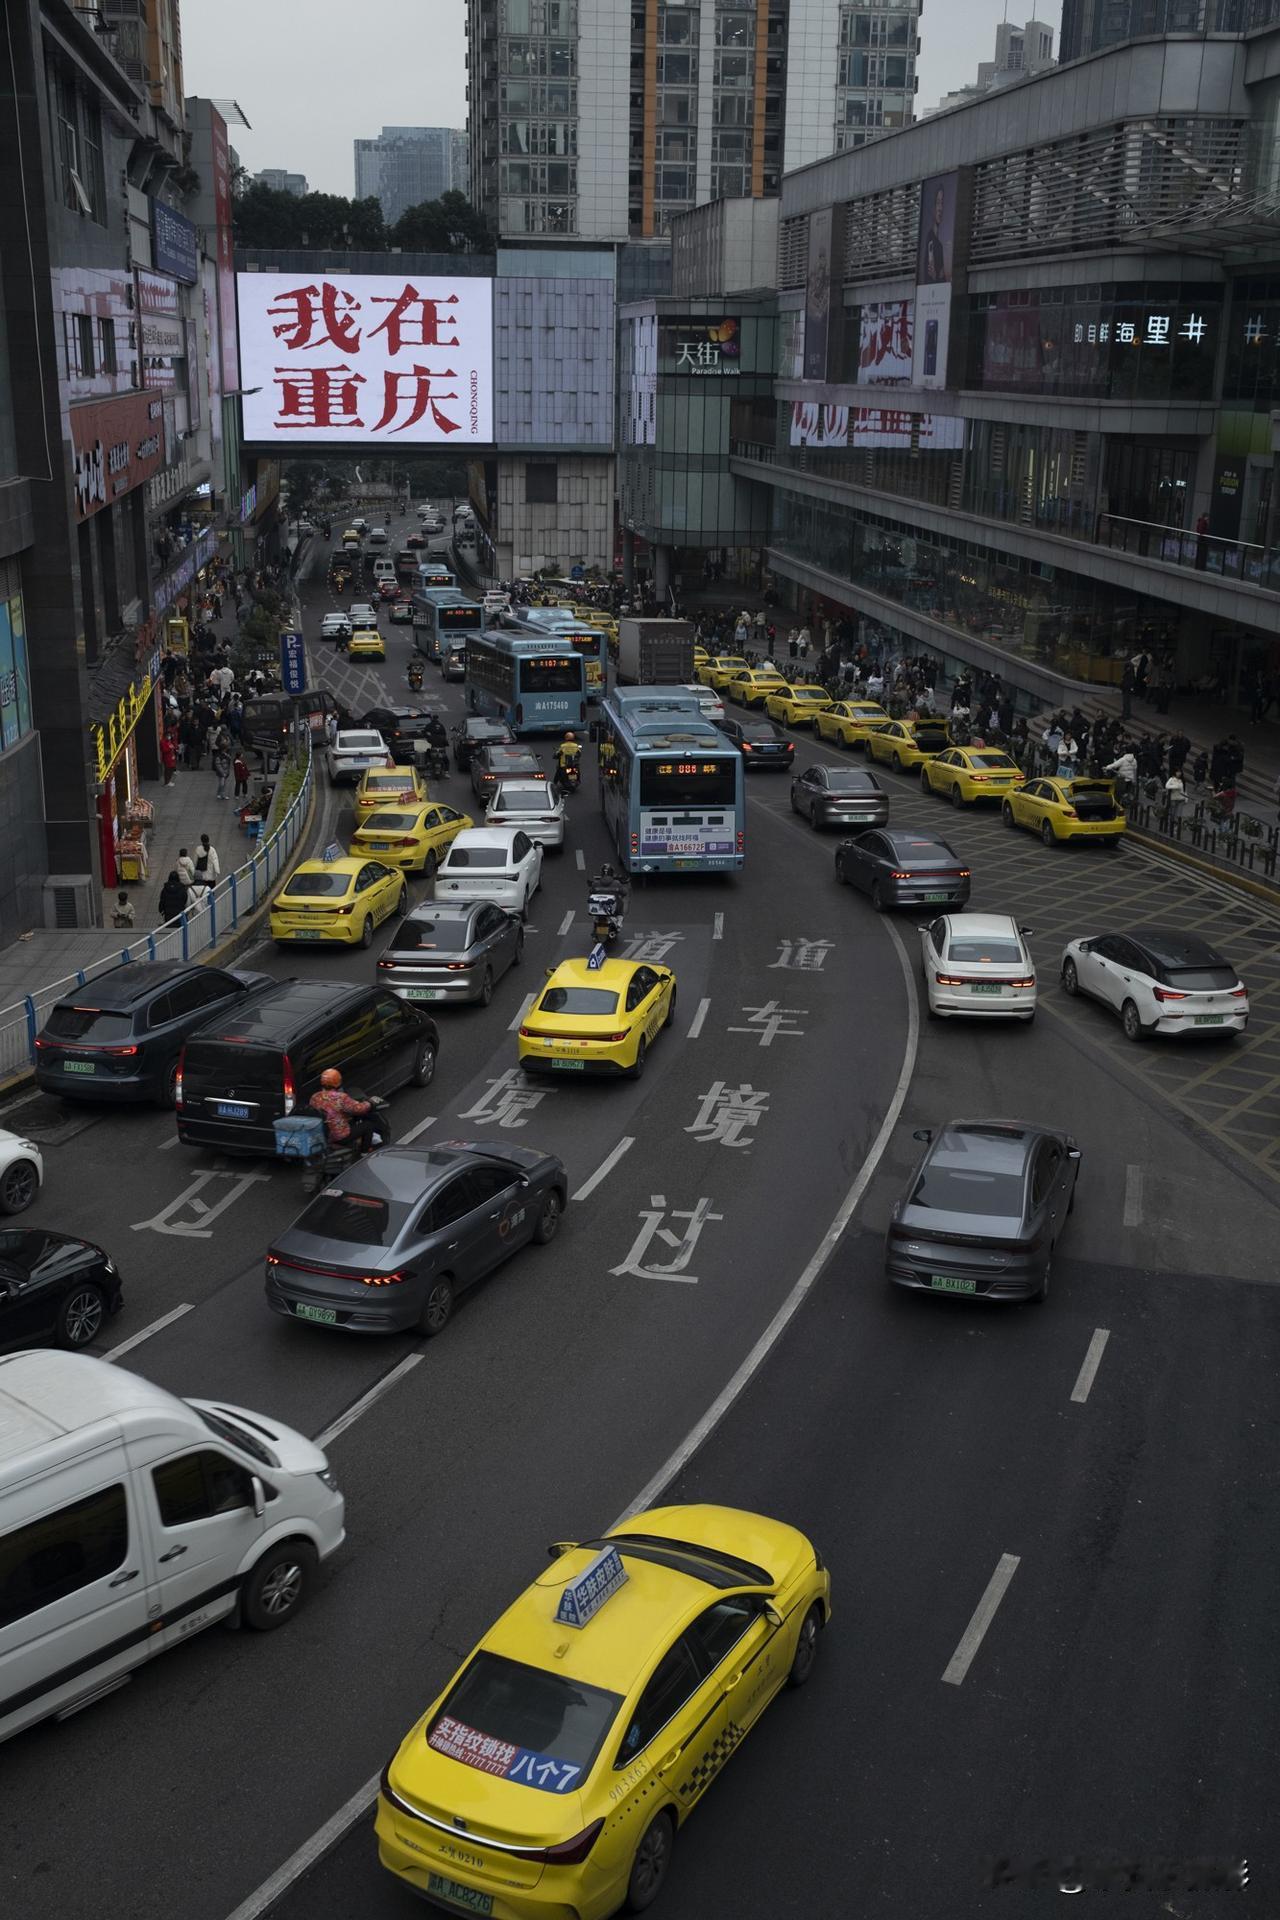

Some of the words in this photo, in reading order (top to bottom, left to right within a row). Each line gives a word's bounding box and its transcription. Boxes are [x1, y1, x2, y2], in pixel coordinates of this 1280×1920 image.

[267, 282, 460, 356] 我在
[675, 342, 720, 365] 天街
[691, 367, 722, 375] Paradise
[723, 367, 741, 375] Walk
[273, 364, 462, 434] 重庆
[470, 370, 478, 434] CHONGQING
[287, 635, 297, 648] P
[620, 931, 687, 964] 道
[766, 938, 836, 971] 道
[726, 1000, 809, 1046] 车
[457, 1068, 559, 1128] 境
[683, 1081, 770, 1147] 境
[608, 1195, 724, 1283] 过
[436, 1717, 515, 1765] 买指纹锁找
[509, 1754, 581, 1791] 八个7
